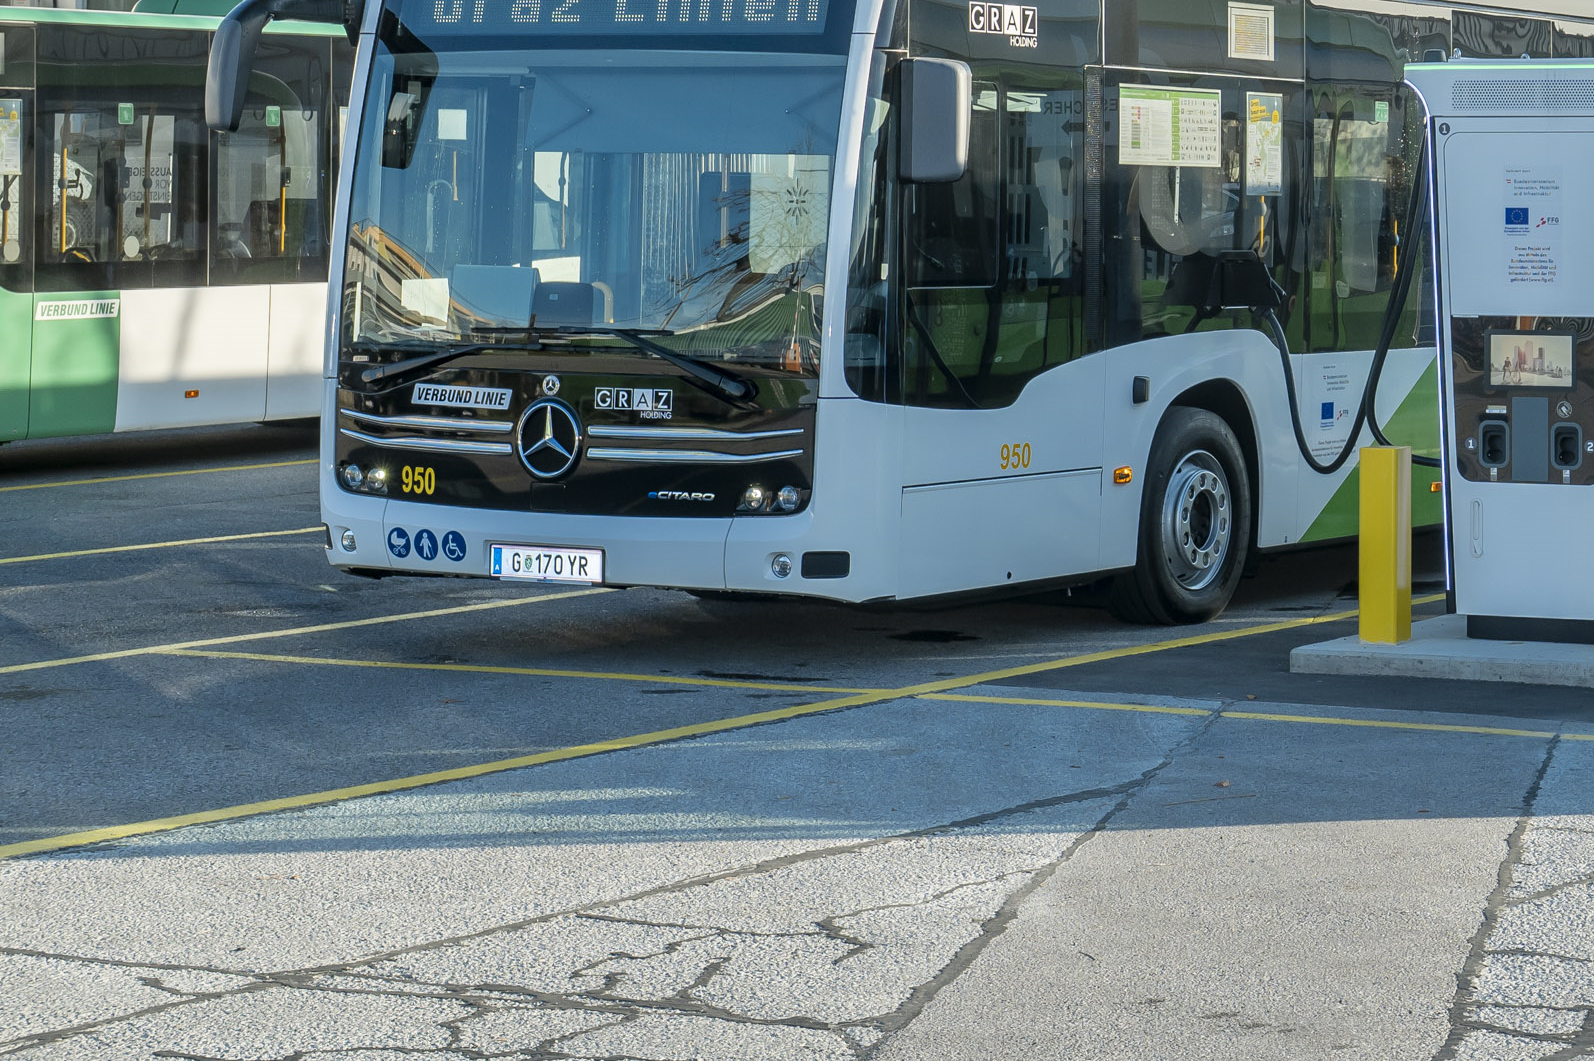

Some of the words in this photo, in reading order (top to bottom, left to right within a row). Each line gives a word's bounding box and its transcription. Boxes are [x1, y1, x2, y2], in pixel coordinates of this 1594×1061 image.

[970, 3, 1036, 35] GRAZ
[1010, 36, 1037, 48] HOLDING
[40, 304, 88, 317] VERBUND
[89, 302, 116, 315] LINIE
[417, 387, 473, 404] VERBUND
[474, 391, 507, 406] LINIE
[595, 388, 672, 411] GRAZ
[640, 410, 672, 419] HOLDING
[1000, 442, 1031, 470] 950
[401, 465, 436, 495] 950
[512, 552, 521, 572] G
[535, 553, 564, 575] 170
[567, 554, 588, 576] YR
